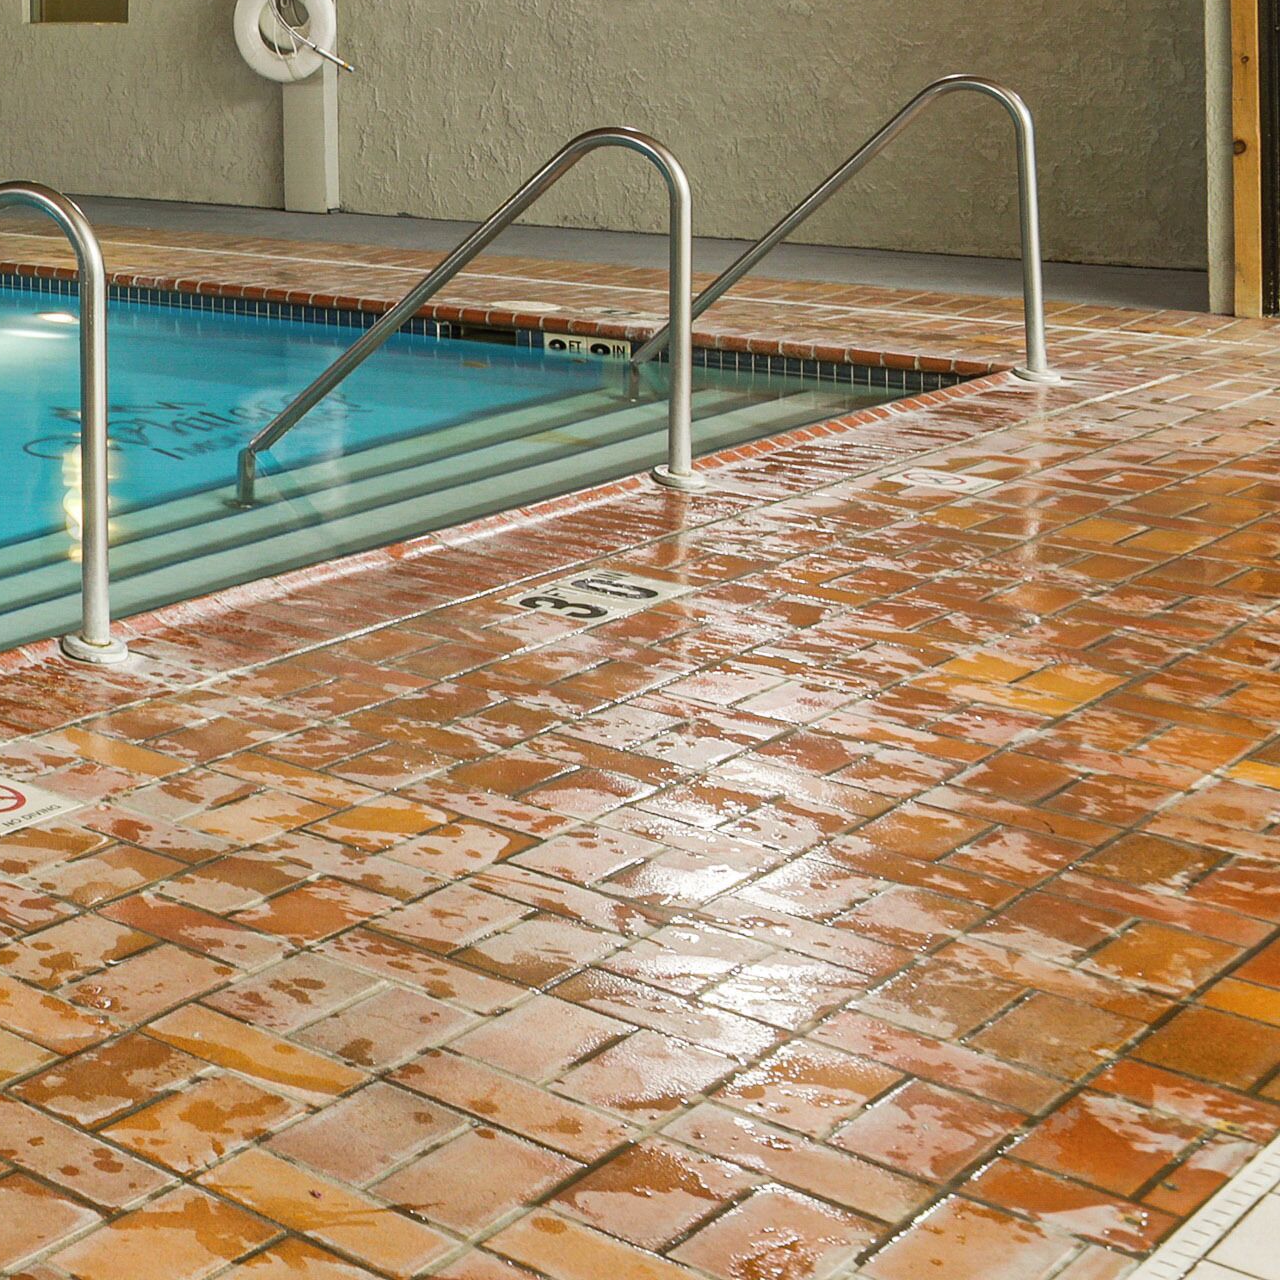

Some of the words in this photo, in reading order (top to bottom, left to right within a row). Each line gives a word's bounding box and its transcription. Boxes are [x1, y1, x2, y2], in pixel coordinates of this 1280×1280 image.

[569, 340, 582, 353] FT
[613, 345, 625, 357] IN
[519, 596, 608, 618] 3
[571, 578, 659, 600] 0
[1, 816, 22, 828] NO
[23, 803, 62, 821] DIVING
